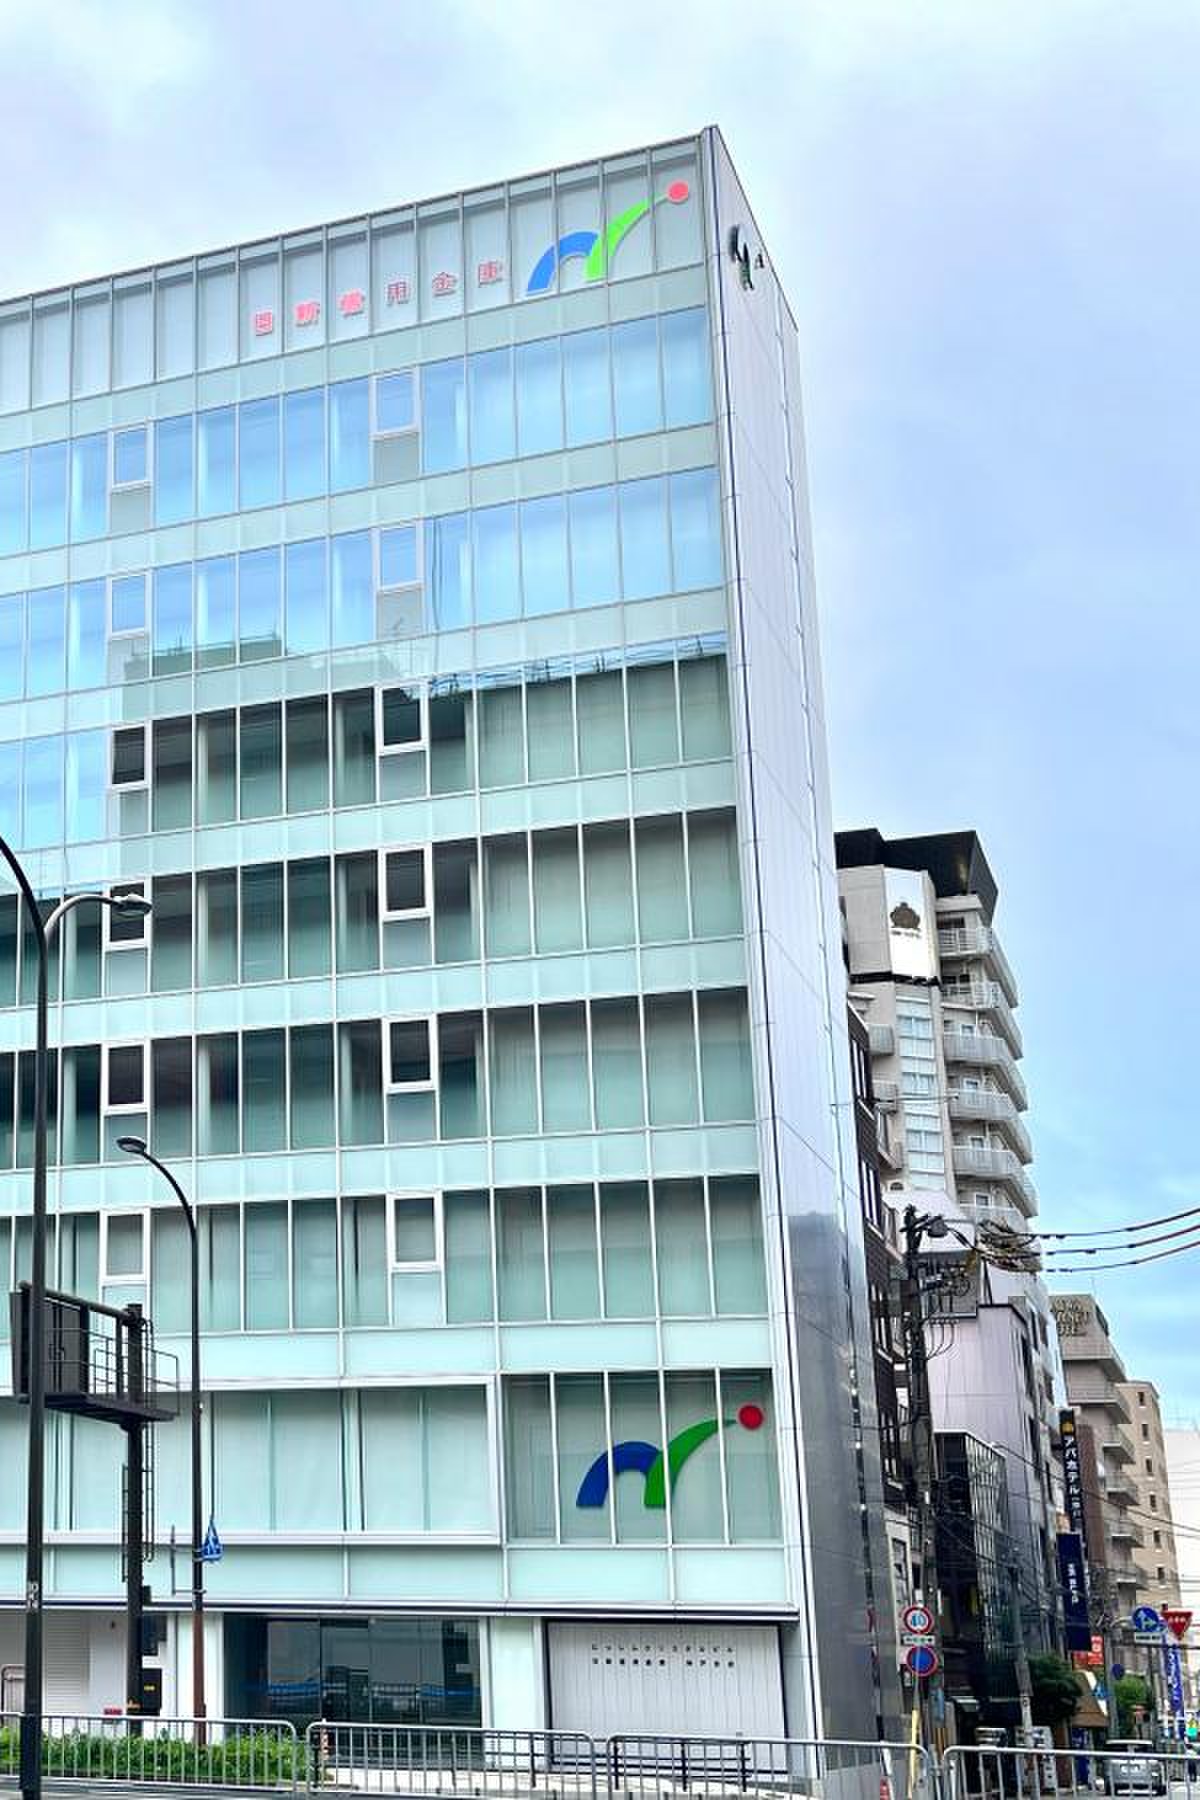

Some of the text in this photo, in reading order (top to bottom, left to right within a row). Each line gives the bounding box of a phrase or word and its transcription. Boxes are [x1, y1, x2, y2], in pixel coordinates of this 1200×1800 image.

[254, 260, 504, 336] 日新信用金庫
